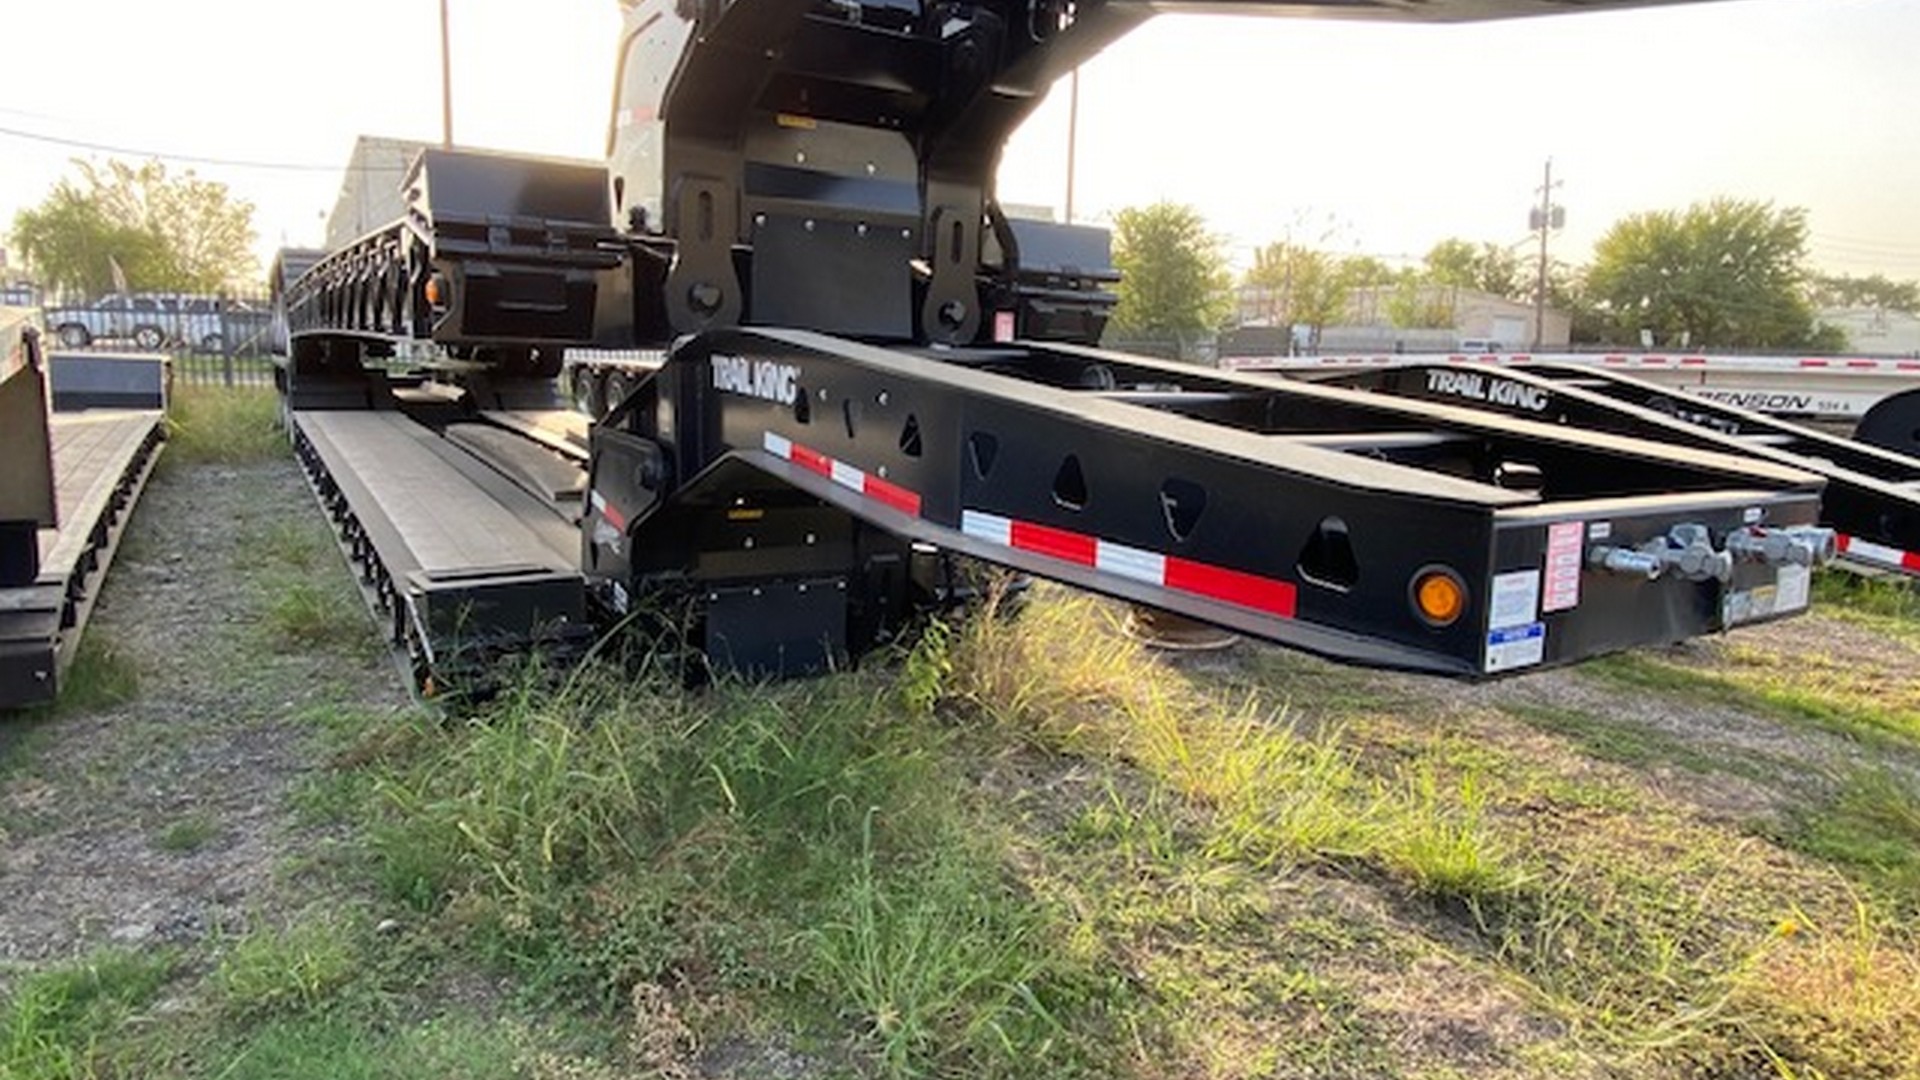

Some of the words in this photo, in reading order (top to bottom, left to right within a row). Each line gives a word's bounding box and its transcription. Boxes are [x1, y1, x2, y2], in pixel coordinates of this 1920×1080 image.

[710, 354, 753, 396] TRAIL
[754, 361, 796, 405] KING
[1426, 369, 1486, 399] TRAIL
[1488, 379, 1548, 411] KING
